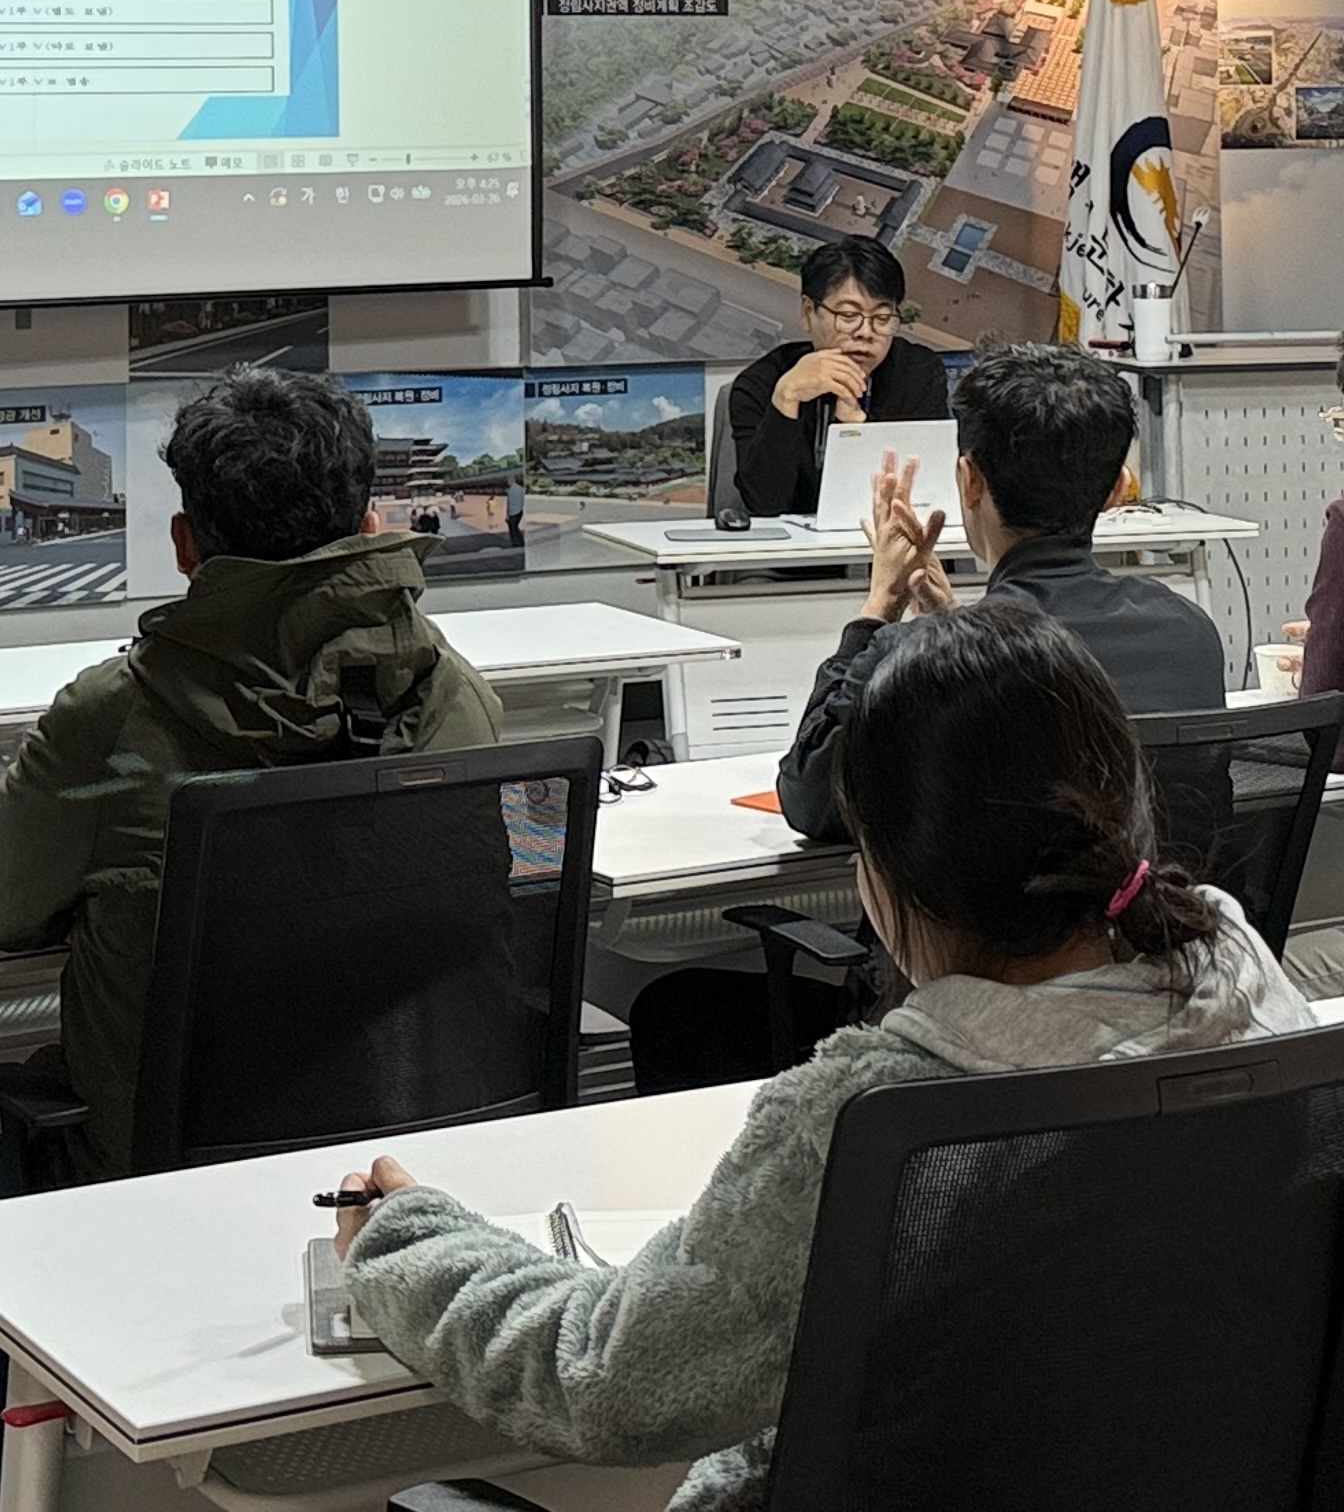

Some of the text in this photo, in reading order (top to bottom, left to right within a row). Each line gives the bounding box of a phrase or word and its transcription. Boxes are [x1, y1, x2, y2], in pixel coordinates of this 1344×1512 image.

[682, 0, 719, 14] 조감도
[119, 158, 191, 172] 슬라이드 노트
[220, 156, 243, 169] 메모
